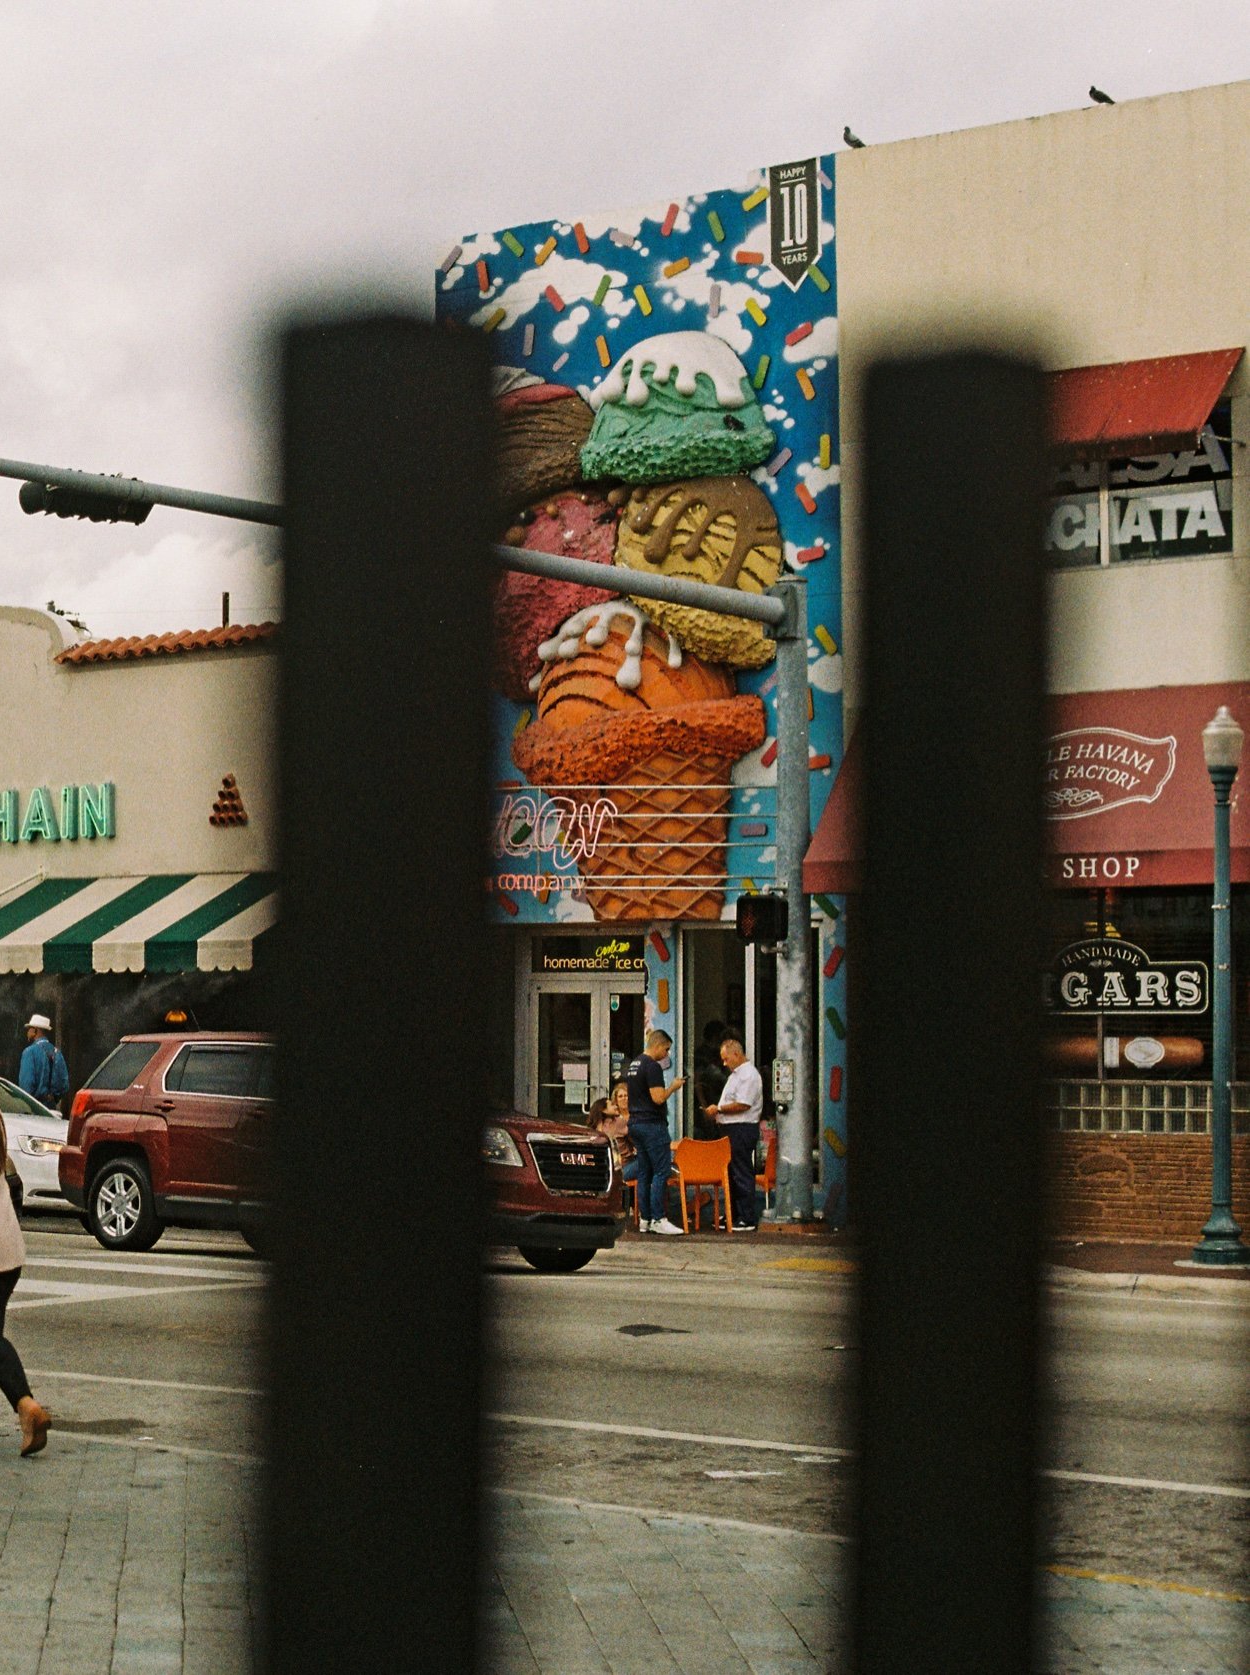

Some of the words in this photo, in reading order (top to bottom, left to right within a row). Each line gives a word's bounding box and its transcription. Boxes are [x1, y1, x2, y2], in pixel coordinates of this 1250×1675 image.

[780, 166, 807, 180] HAPPY
[780, 183, 808, 248] 10
[781, 252, 808, 266] YEARS
[1076, 743, 1156, 775] HAVANA
[1064, 765, 1141, 791] FACTORY
[1062, 857, 1141, 879] SHOP
[497, 873, 586, 897] company
[544, 954, 609, 969] homemade
[615, 956, 631, 969] ice
[633, 957, 645, 969] cr
[1062, 946, 1141, 968] HANDMADE
[1060, 970, 1202, 1008] GARS
[561, 1152, 595, 1166] GMC
